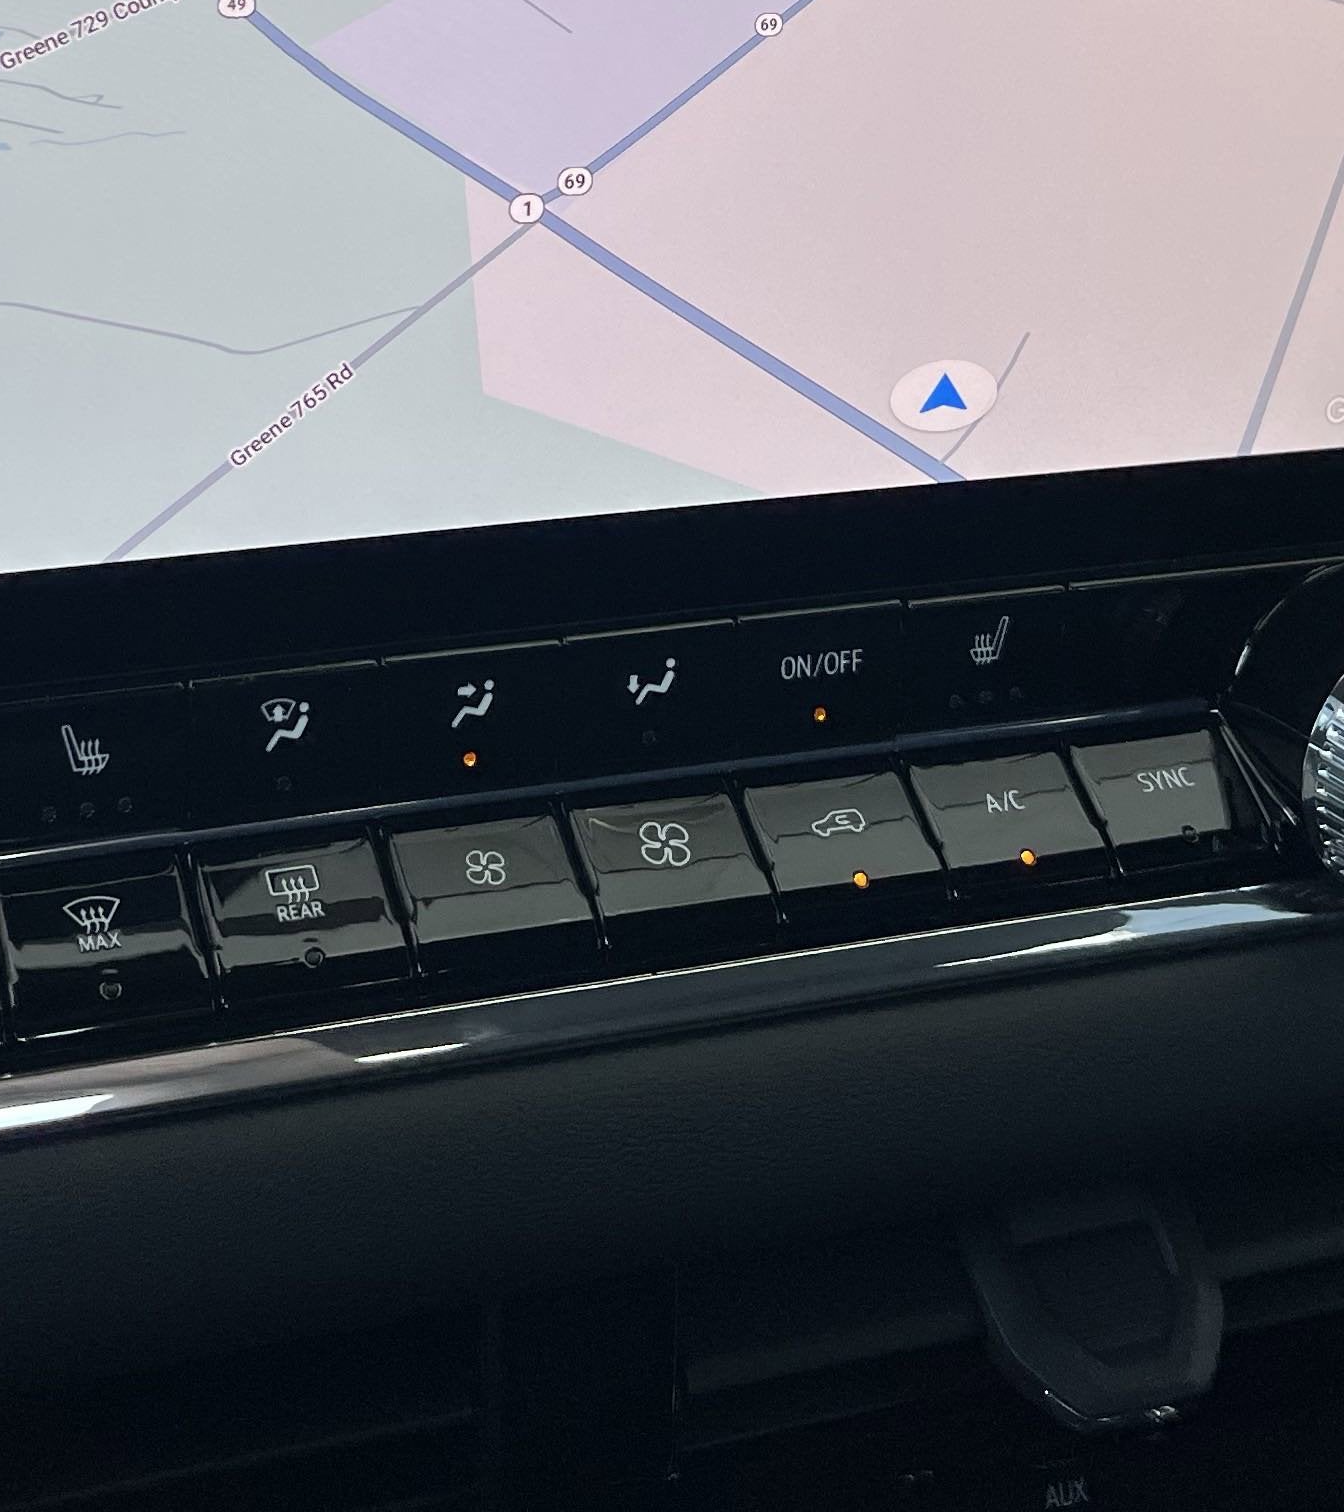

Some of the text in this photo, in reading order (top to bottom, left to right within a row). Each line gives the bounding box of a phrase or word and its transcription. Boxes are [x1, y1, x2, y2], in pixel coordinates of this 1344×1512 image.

[759, 17, 778, 32] 69
[0, 30, 70, 70] Greene
[70, 10, 109, 39] 729
[564, 173, 585, 189] 69
[229, 362, 354, 466] Greene 765 Rd
[780, 648, 864, 680] ON/OFF
[1136, 766, 1196, 794] SYNC
[985, 789, 1026, 814] A/C
[275, 901, 326, 923] REAR
[77, 931, 122, 952] MAX
